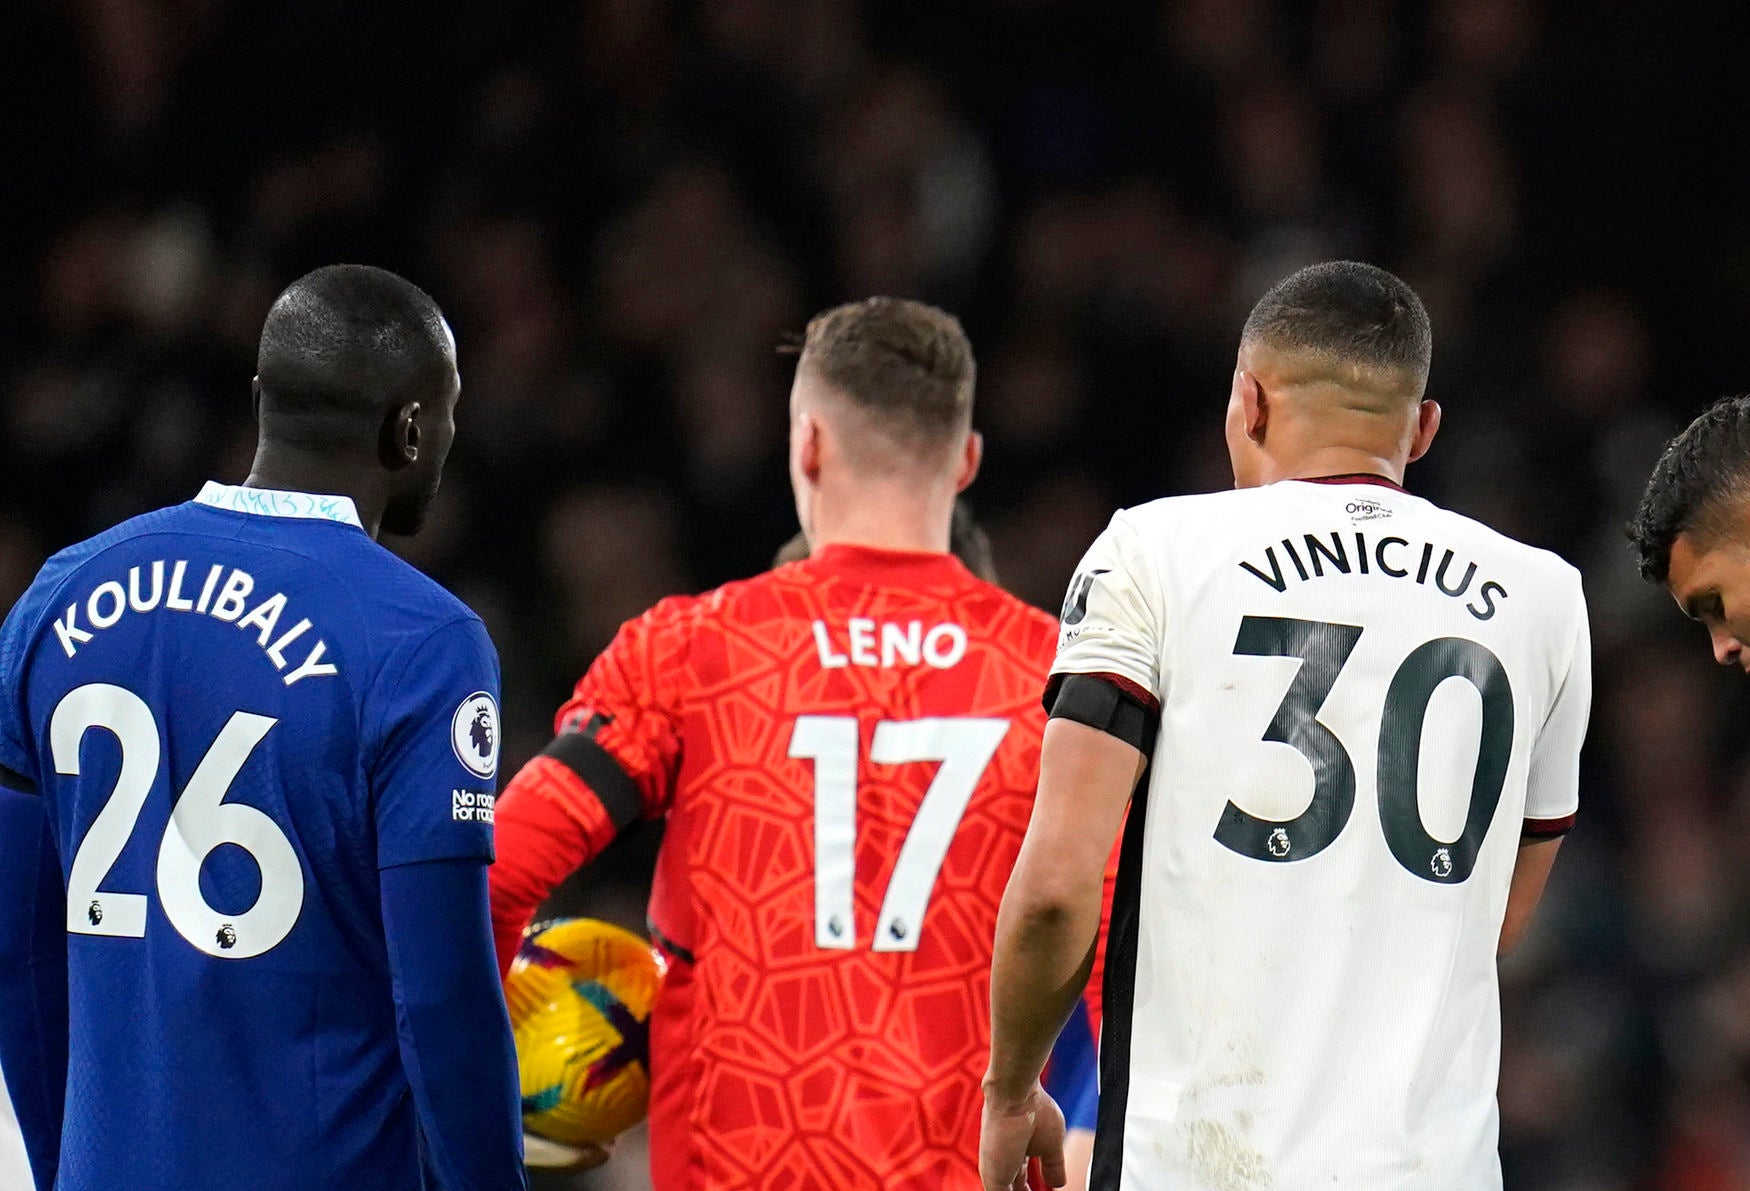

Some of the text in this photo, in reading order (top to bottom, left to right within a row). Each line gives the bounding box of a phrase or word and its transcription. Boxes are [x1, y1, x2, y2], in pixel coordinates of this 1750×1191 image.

[53, 560, 338, 686] KOULIBALY
[1239, 532, 1508, 621] VINICIUS
[811, 618, 969, 669] LENO
[452, 789, 475, 806] No
[1213, 615, 1515, 884] 30
[50, 683, 304, 958] 26
[787, 714, 1010, 952] 17
